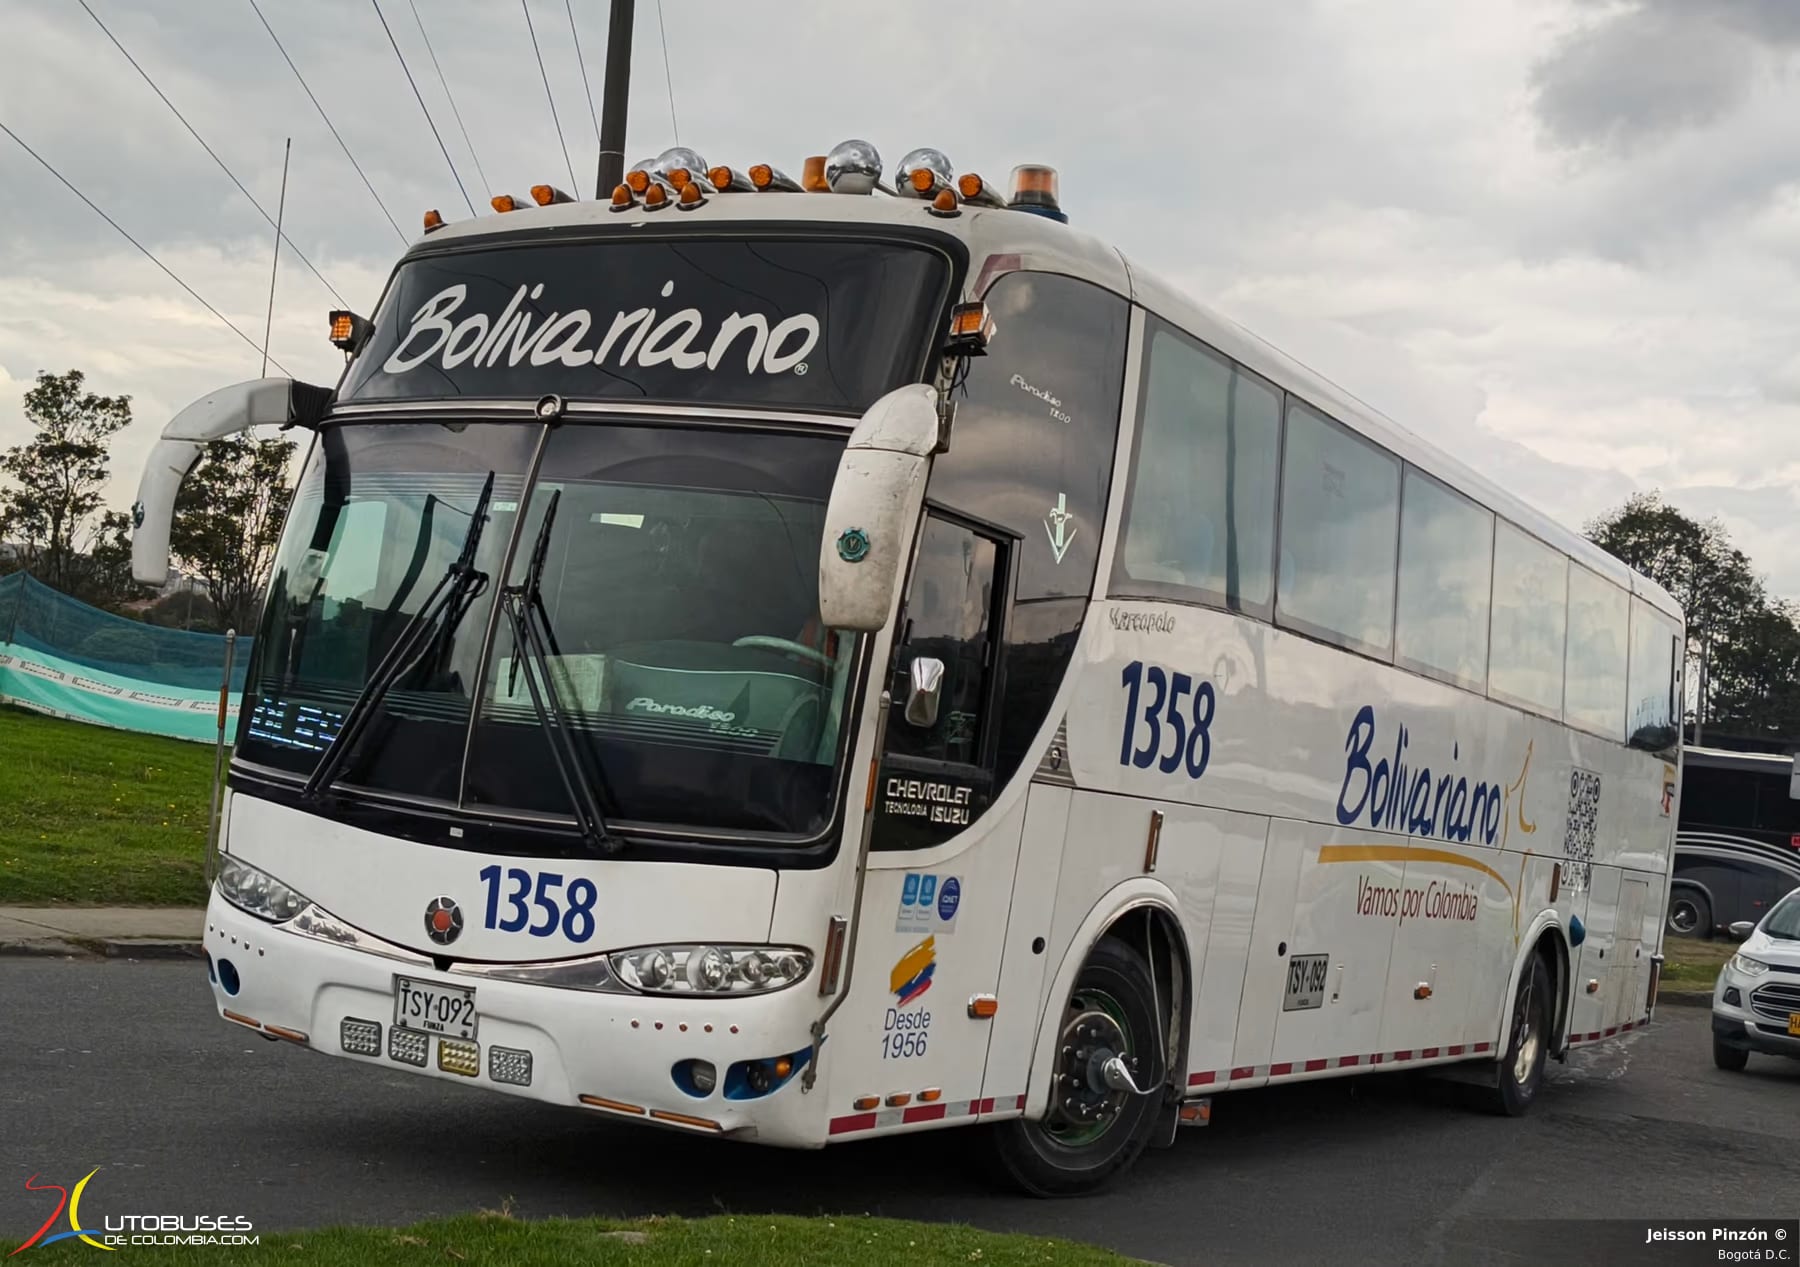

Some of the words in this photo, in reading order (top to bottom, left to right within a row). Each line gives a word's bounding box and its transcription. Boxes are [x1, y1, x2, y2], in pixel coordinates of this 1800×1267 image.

[1010, 373, 1062, 407] Paradiso
[626, 697, 735, 722] Paradiso
[1120, 660, 1215, 779] 1358
[1336, 705, 1501, 845] Bolivariano
[887, 778, 972, 805] CHEVROLET
[930, 806, 970, 825] ISUZU
[480, 864, 598, 943] 1358
[1357, 874, 1400, 917] Vamos
[1399, 888, 1424, 928] por
[1425, 880, 1478, 921] Colombia
[884, 1006, 931, 1032] Desde
[882, 1031, 928, 1059] 1956
